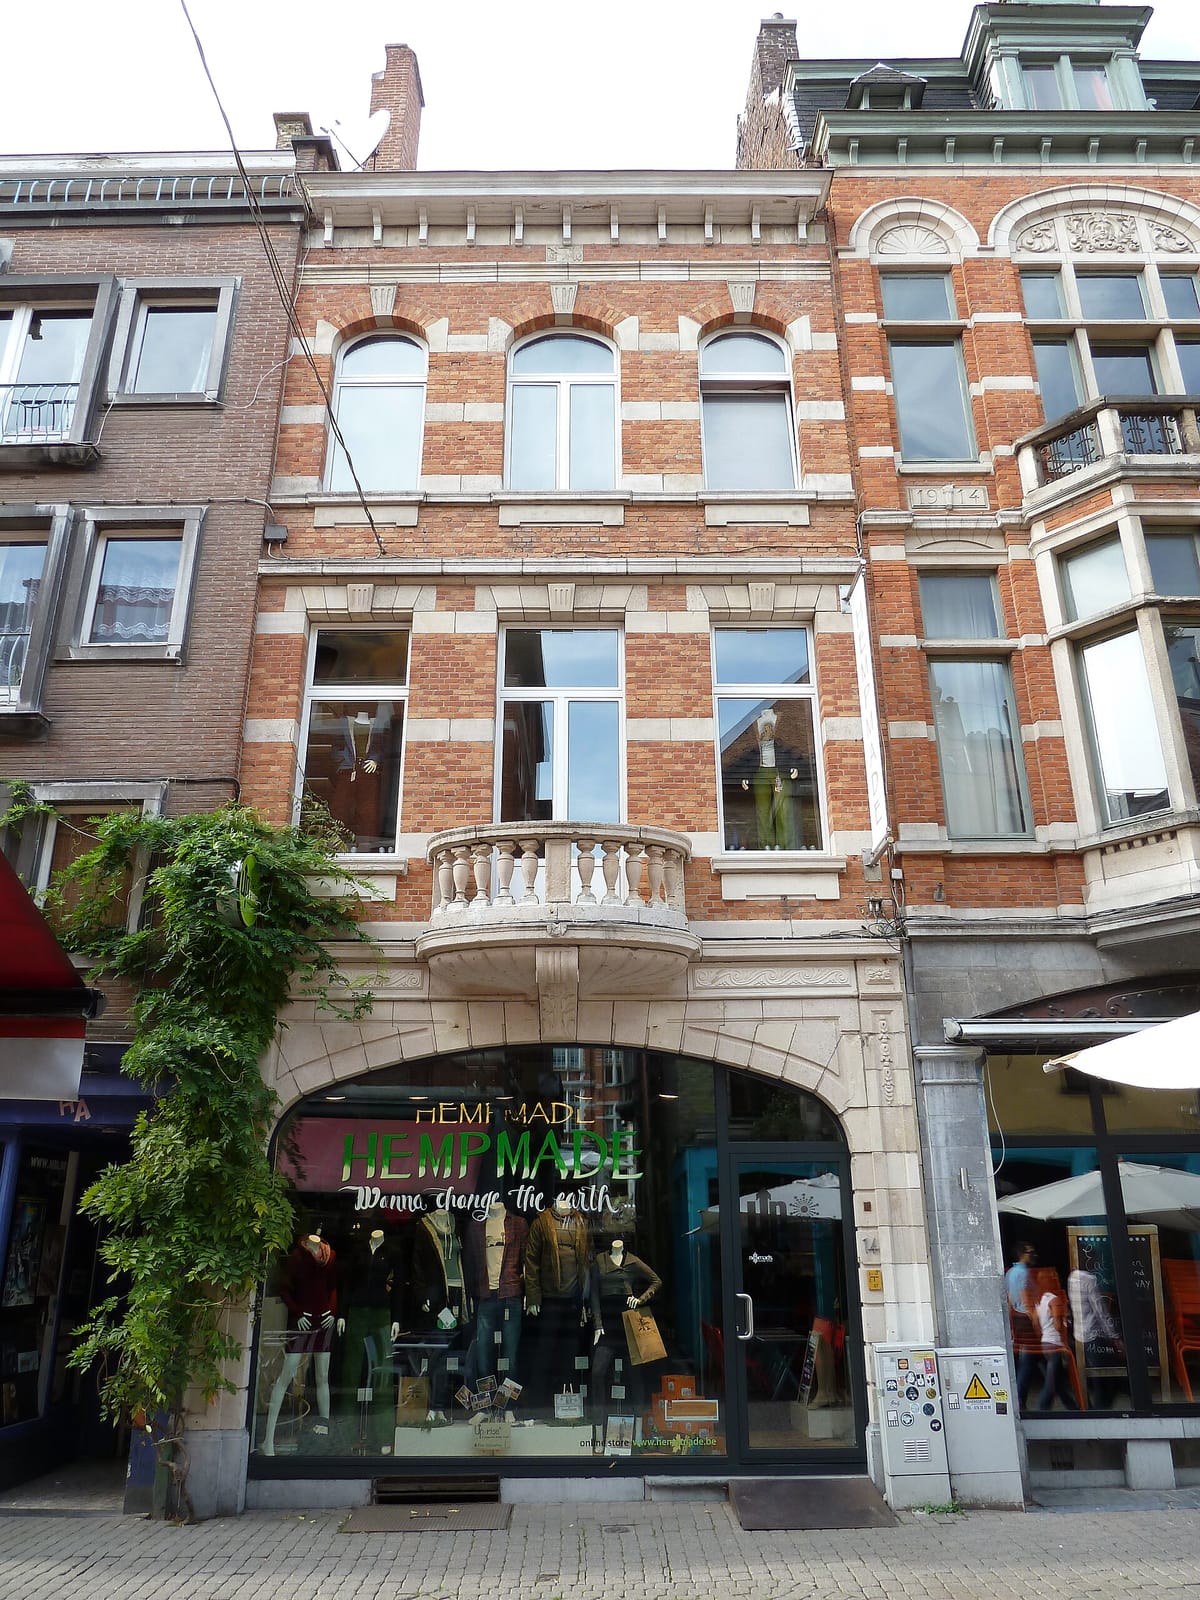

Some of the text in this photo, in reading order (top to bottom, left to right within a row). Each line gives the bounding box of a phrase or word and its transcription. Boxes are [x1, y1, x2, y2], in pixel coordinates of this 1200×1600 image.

[917, 489, 980, 504] 19 14
[338, 1185, 428, 1213] Wanna
[423, 1186, 500, 1222] change
[508, 1184, 546, 1212] the
[554, 1184, 620, 1213] earth
